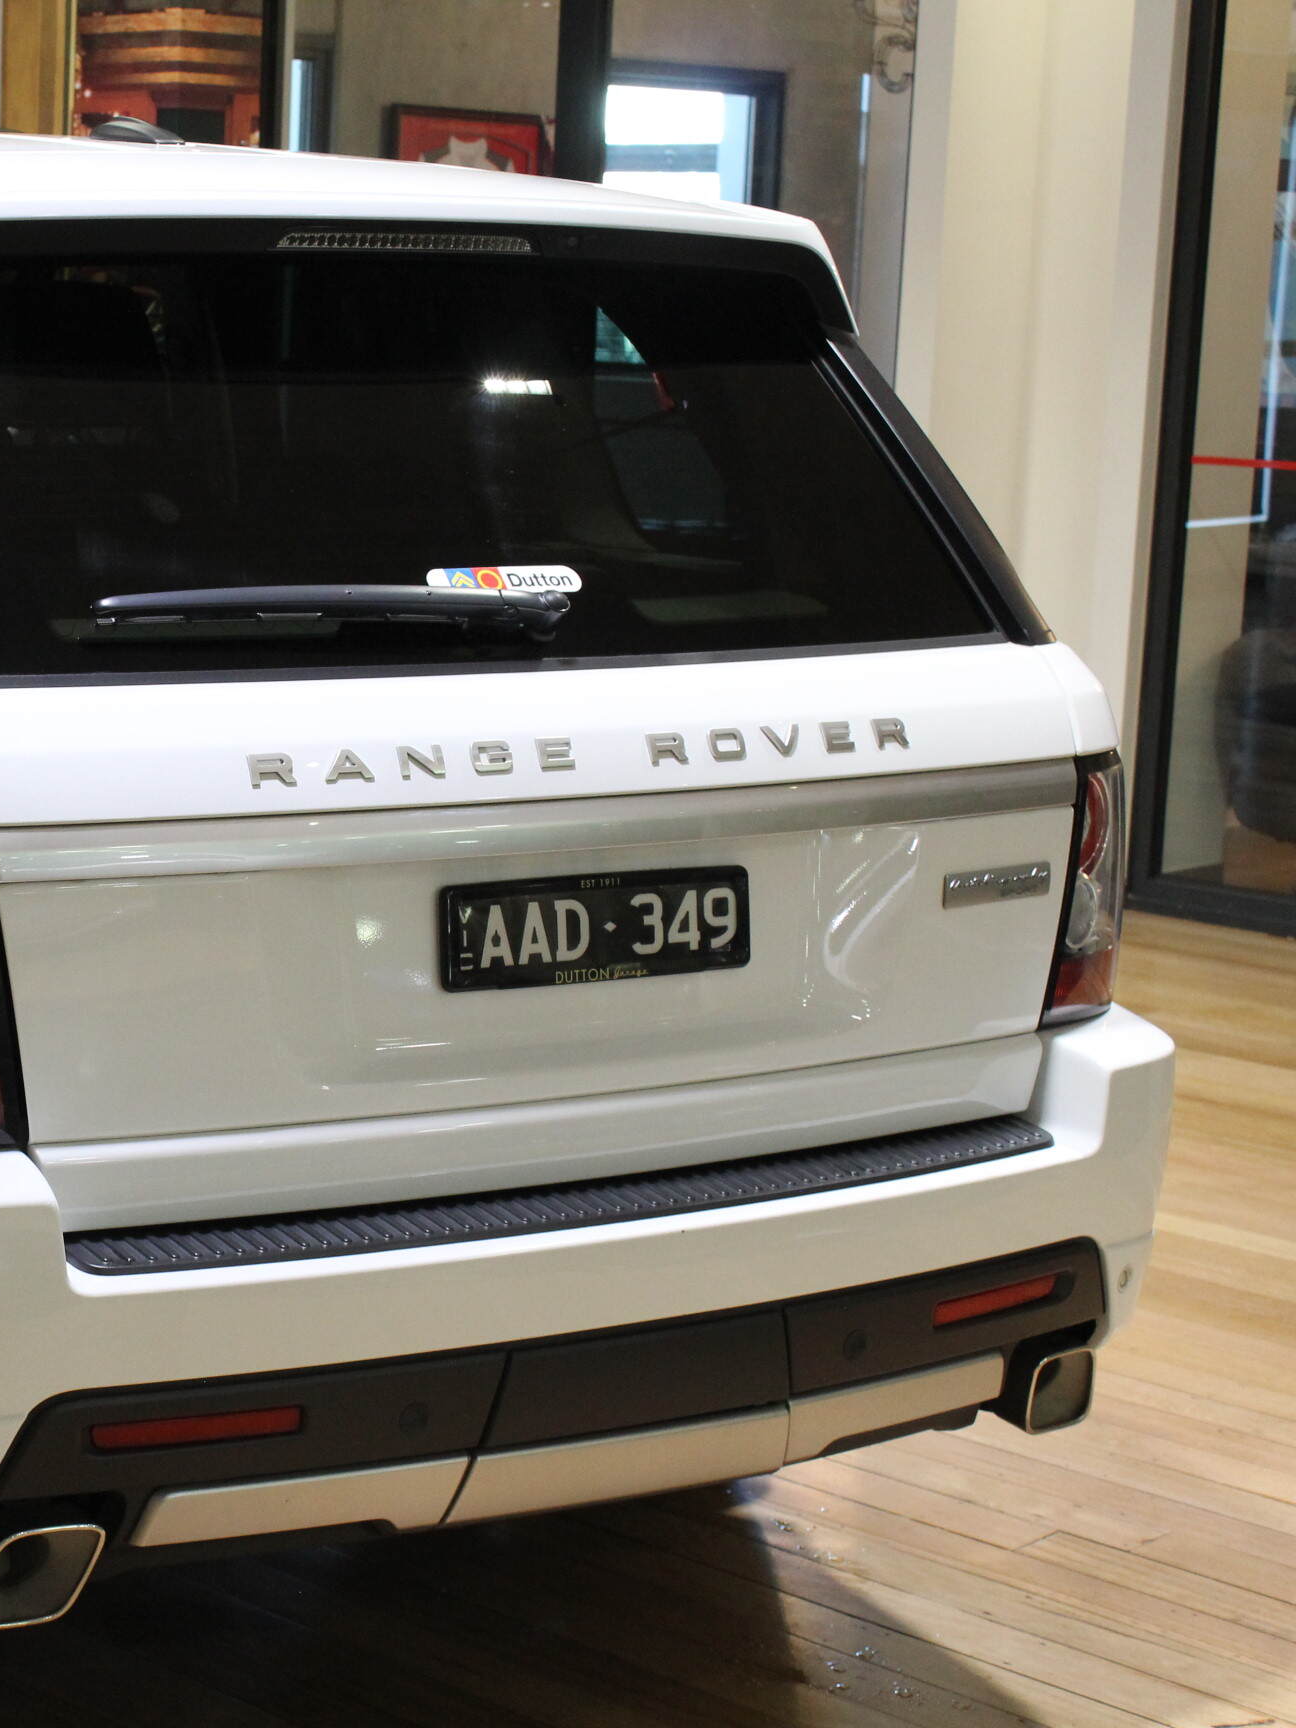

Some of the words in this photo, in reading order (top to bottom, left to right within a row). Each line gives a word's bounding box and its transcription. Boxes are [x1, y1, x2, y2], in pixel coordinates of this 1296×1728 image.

[507, 573, 573, 587] Dutton
[247, 736, 575, 789] RANGE
[645, 716, 910, 766] ROVER
[480, 899, 590, 969] AAD
[630, 887, 737, 956] 349
[555, 967, 610, 984] DUTTON
